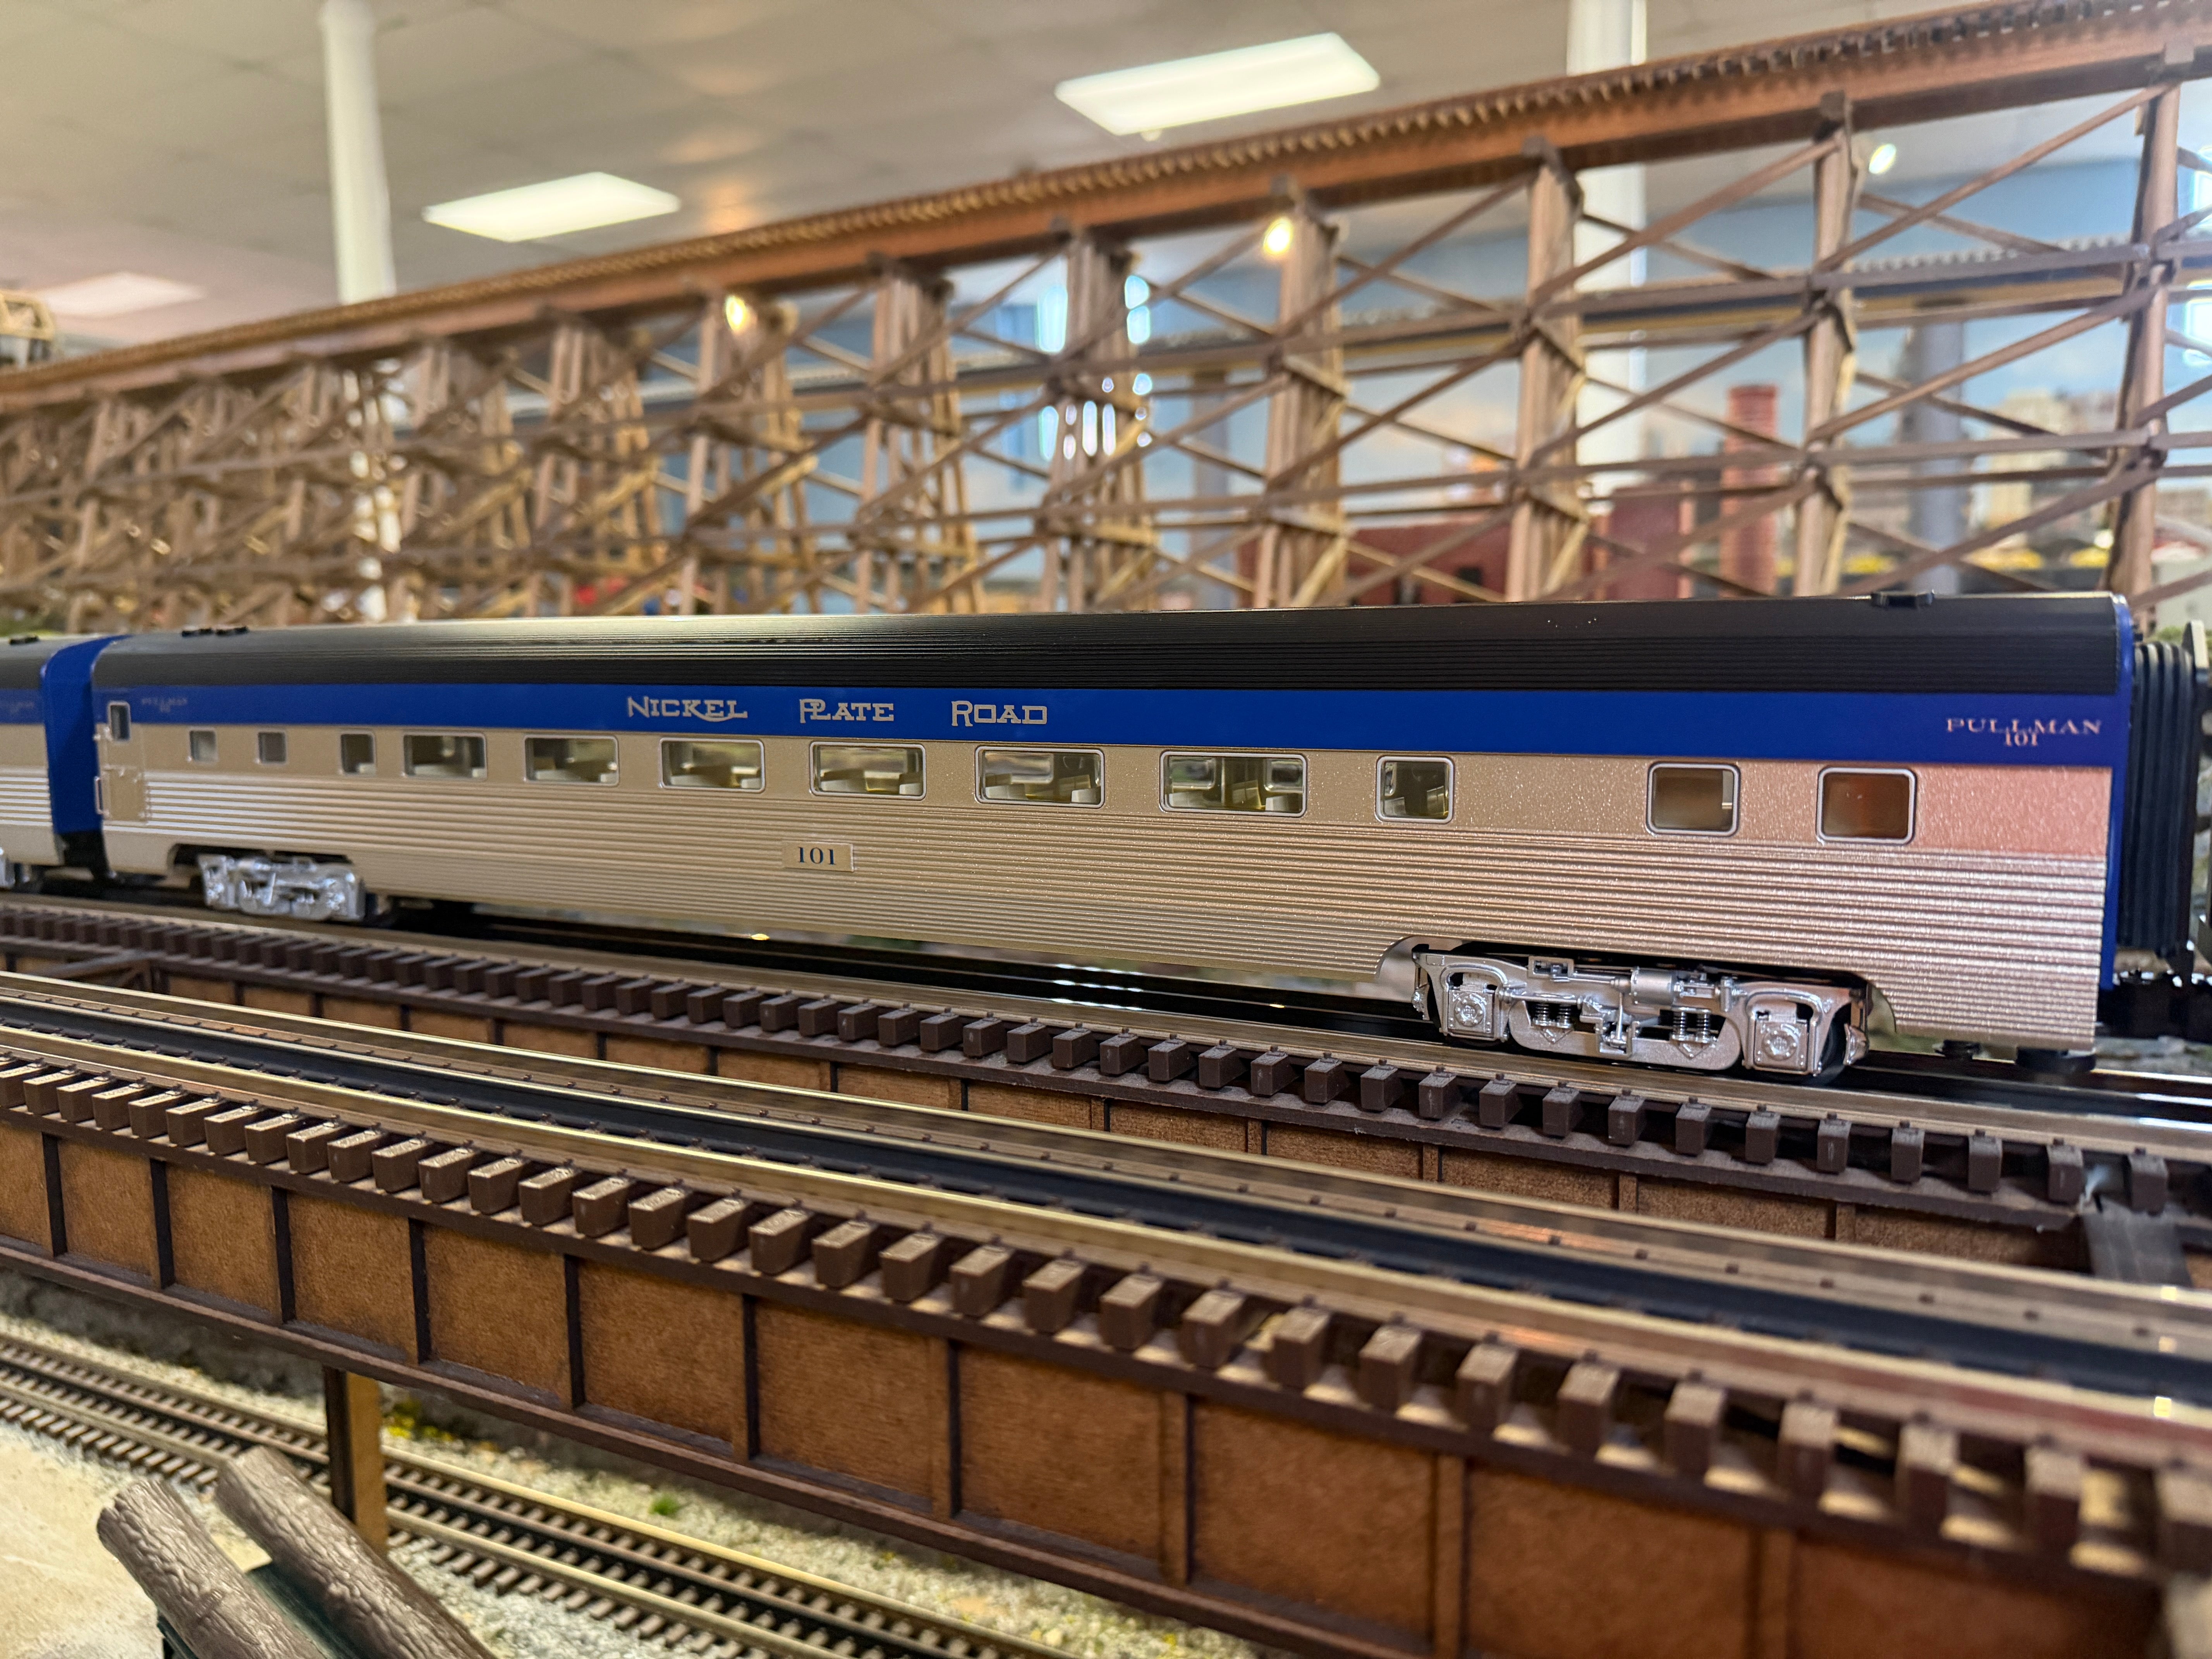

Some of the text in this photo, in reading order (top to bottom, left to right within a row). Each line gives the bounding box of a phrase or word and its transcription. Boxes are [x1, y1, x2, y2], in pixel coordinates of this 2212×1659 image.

[627, 696, 1048, 727] NICKEL PLATE ROAD
[1946, 718, 2102, 734] PULLMAN
[2005, 728, 2038, 747] 101
[798, 847, 836, 865] 101
